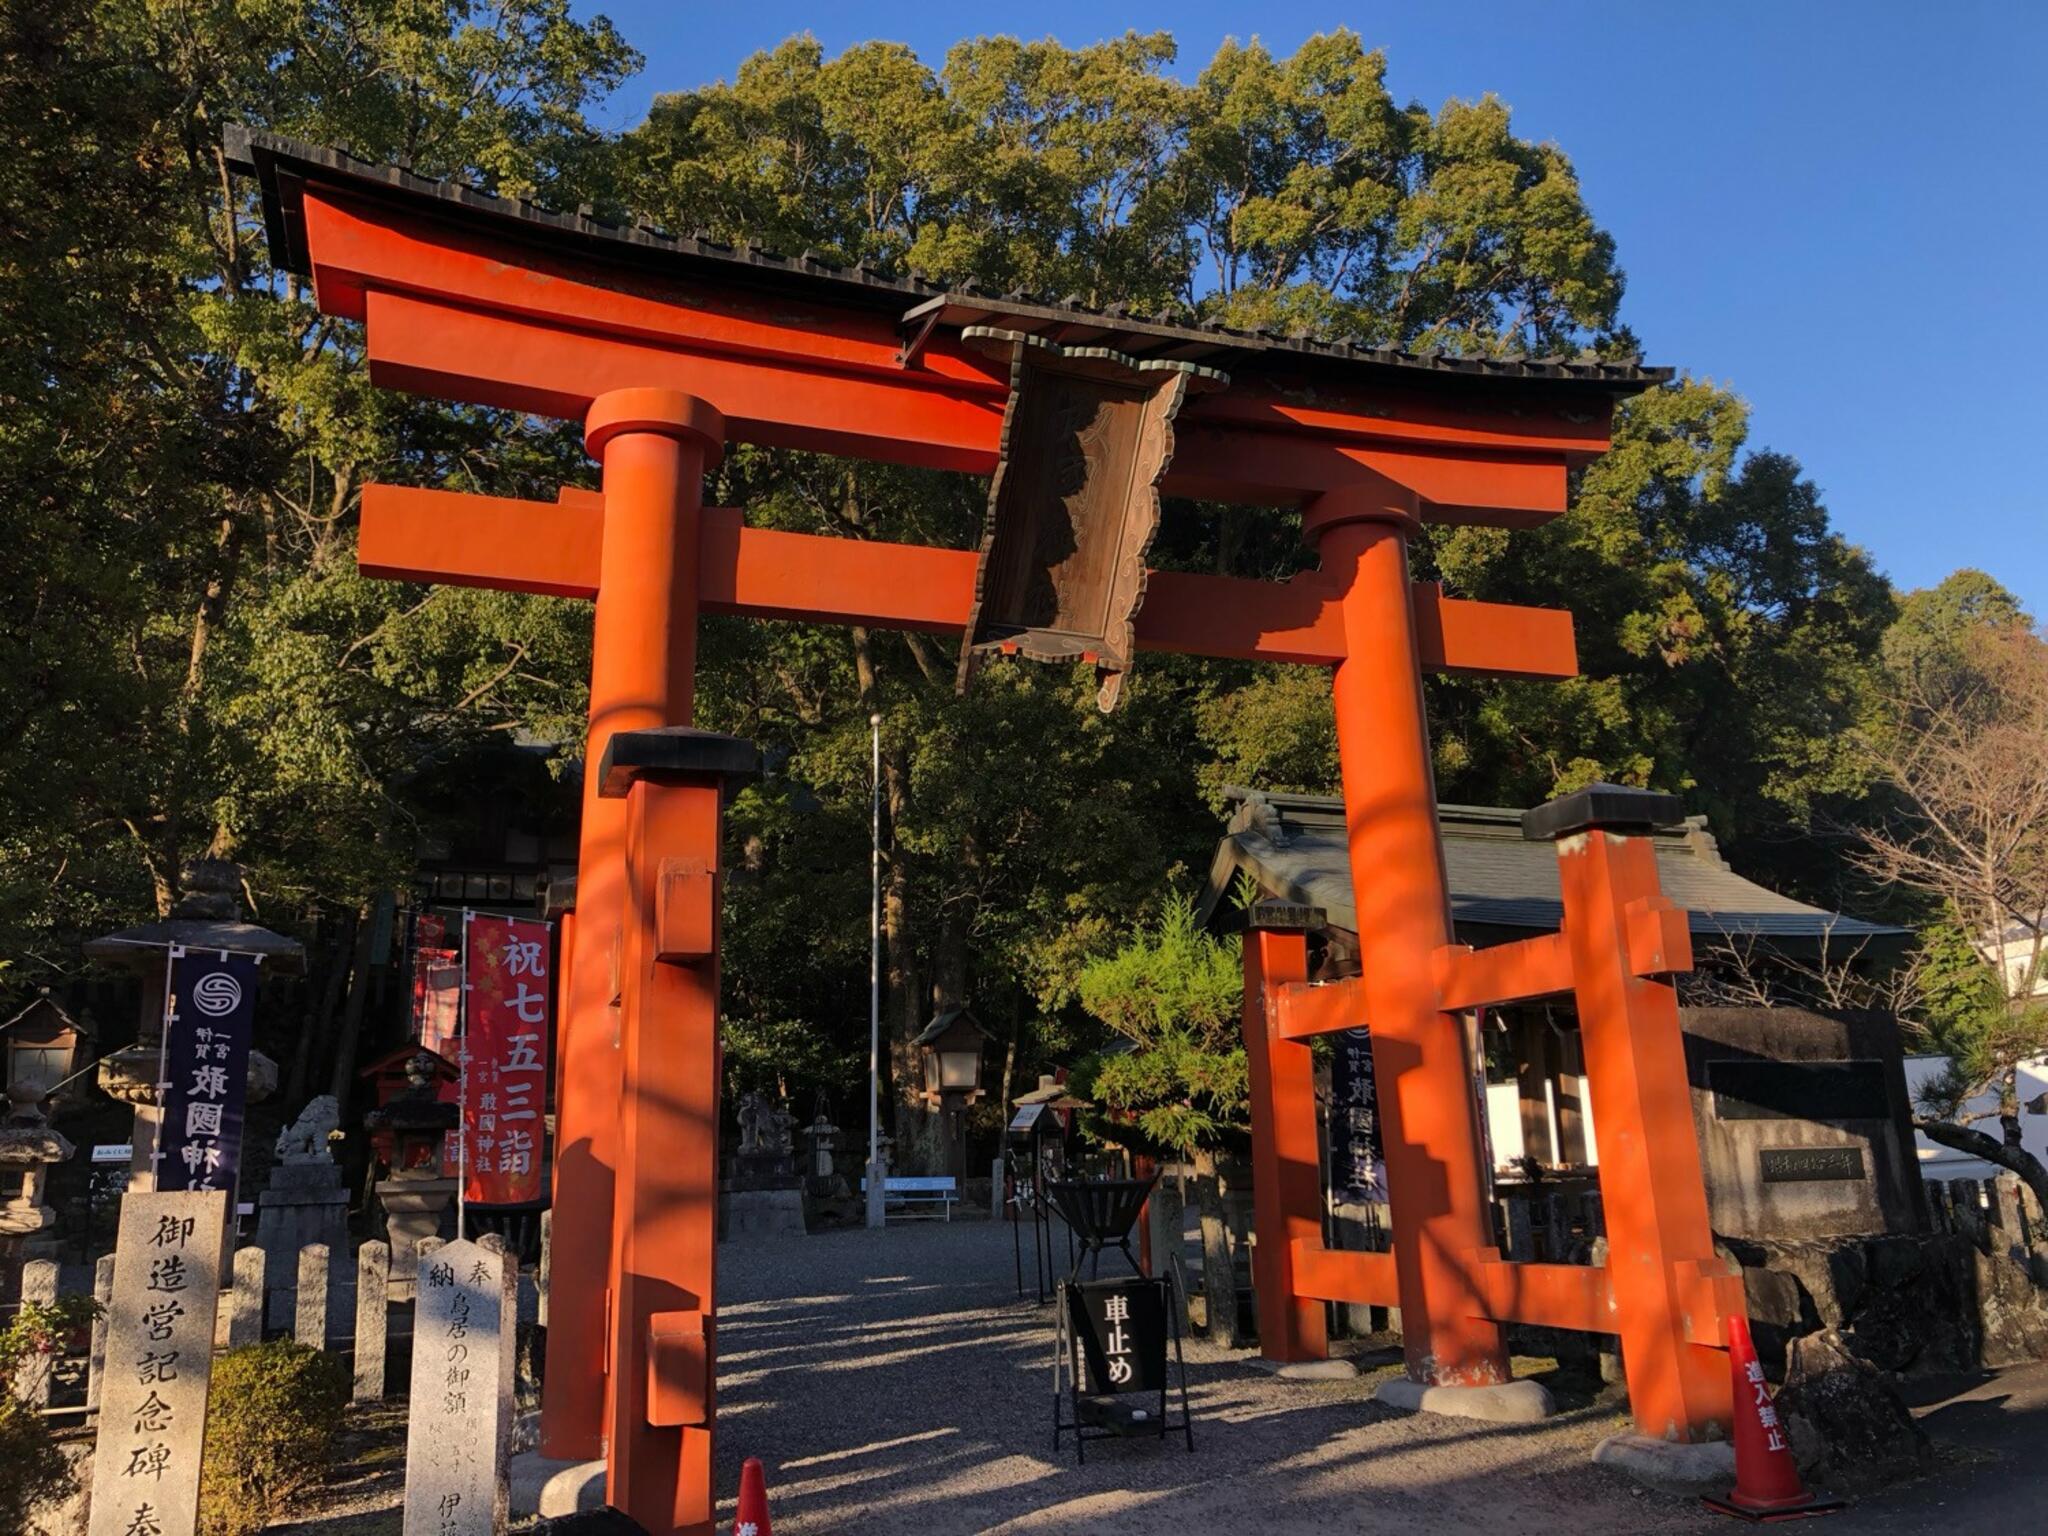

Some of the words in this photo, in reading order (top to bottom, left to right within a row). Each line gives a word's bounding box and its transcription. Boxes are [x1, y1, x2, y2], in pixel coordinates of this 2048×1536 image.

[499, 934, 545, 1175] 祝七五三詣
[475, 1093, 497, 1173] 敢國神社
[121, 1214, 195, 1483] 御造営記念碑
[443, 1292, 470, 1415] 鳥居の御額
[1104, 1294, 1132, 1385] 車止め
[1745, 1360, 1785, 1452] 進入禁止
